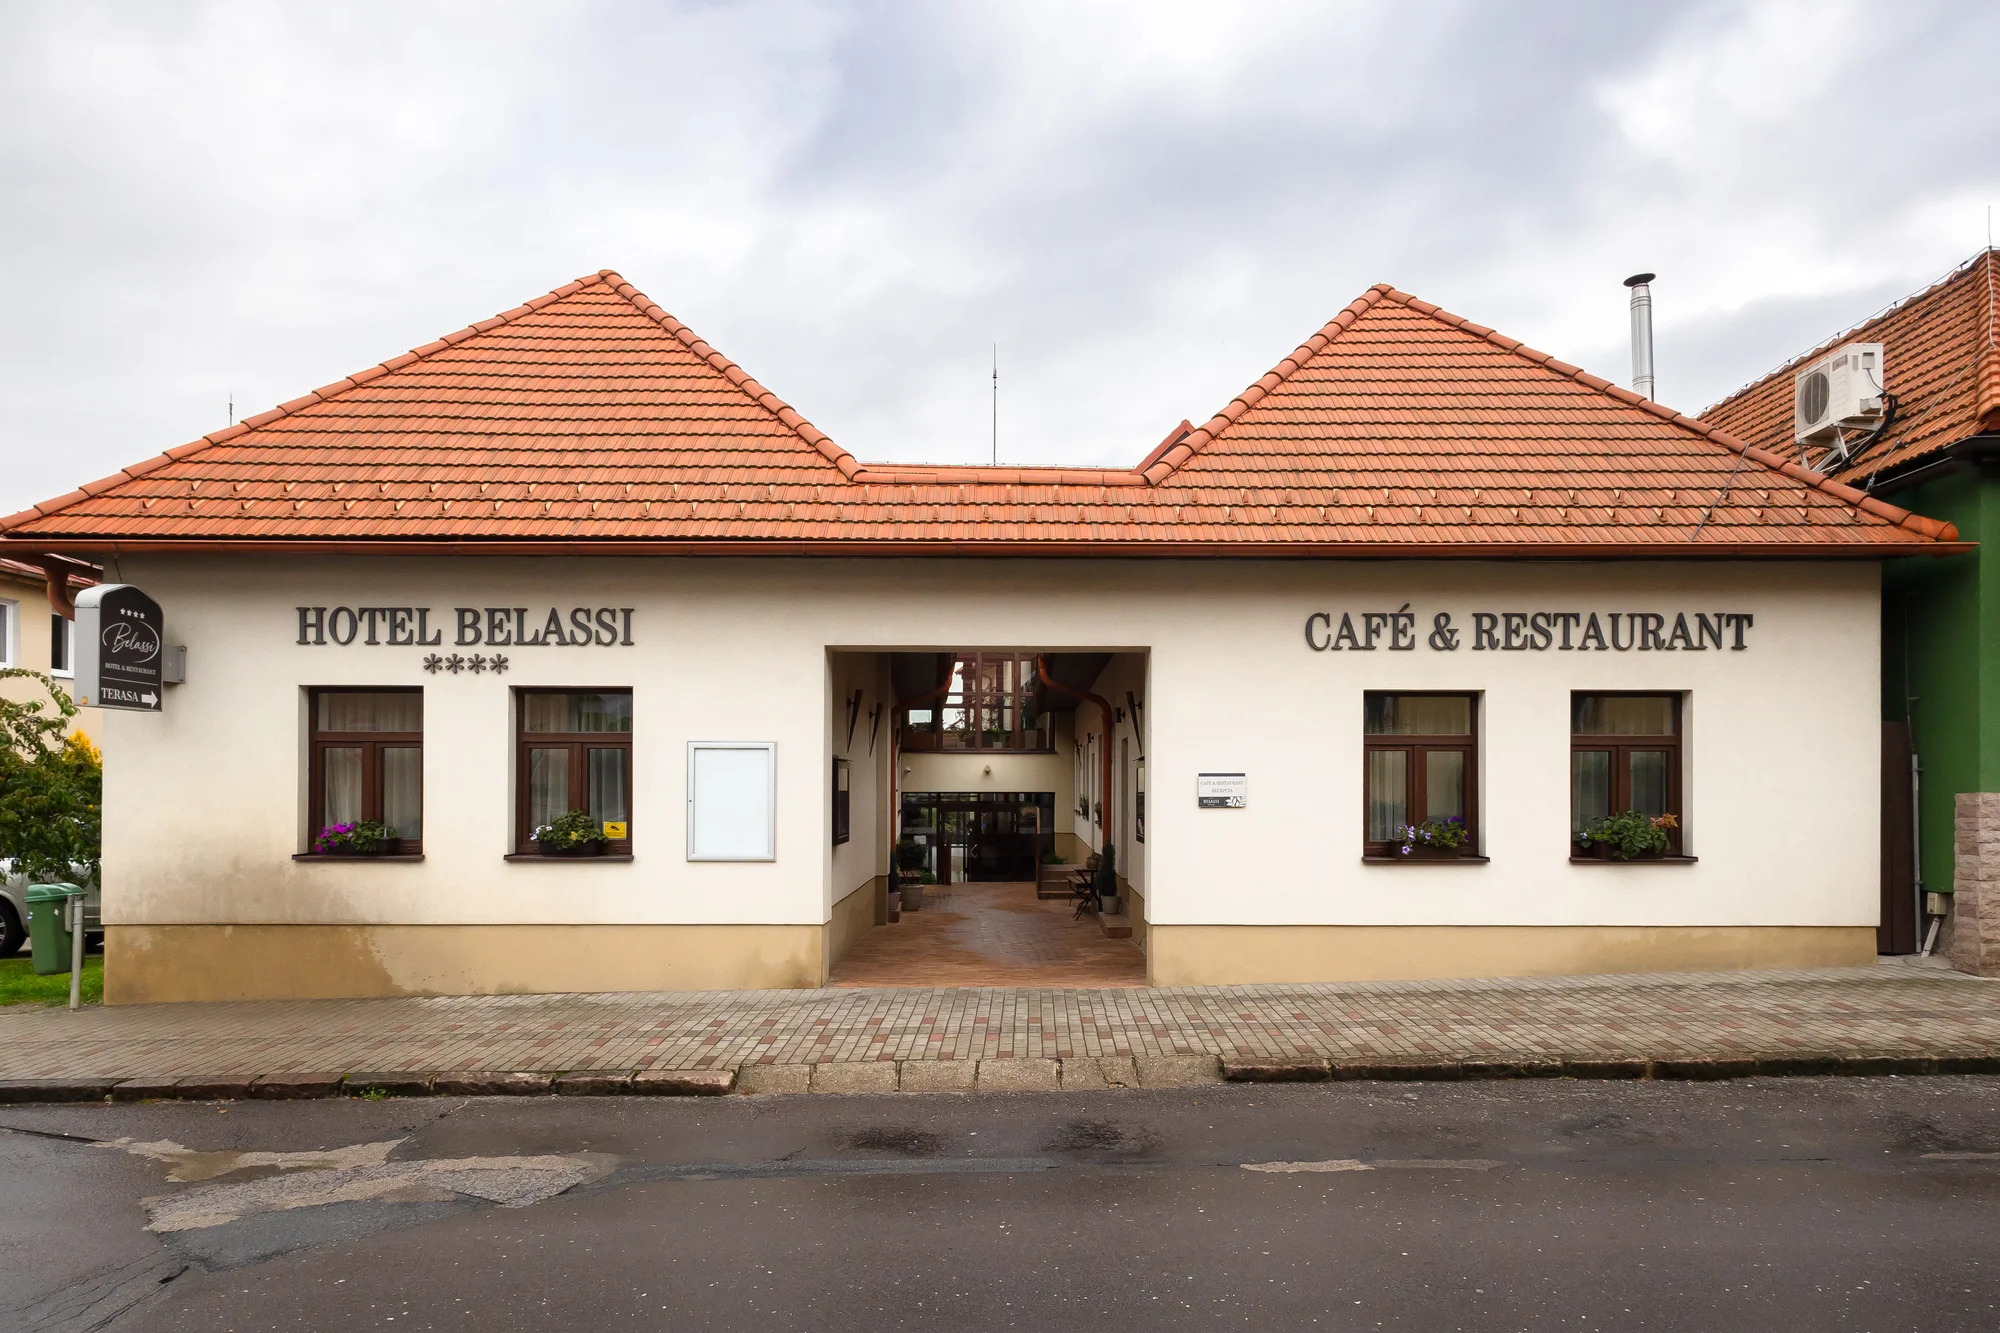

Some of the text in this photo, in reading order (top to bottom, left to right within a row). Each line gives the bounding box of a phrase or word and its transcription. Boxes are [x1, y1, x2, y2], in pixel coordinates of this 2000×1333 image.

[112, 622, 156, 653] Belassi
[295, 606, 635, 646] HOTEL BELASSI
[1305, 603, 1754, 651] CAFÉ & RESTAURANT
[105, 662, 121, 670] HOTEL
[126, 665, 156, 675] RESTAURANT
[101, 687, 139, 702] TERASA
